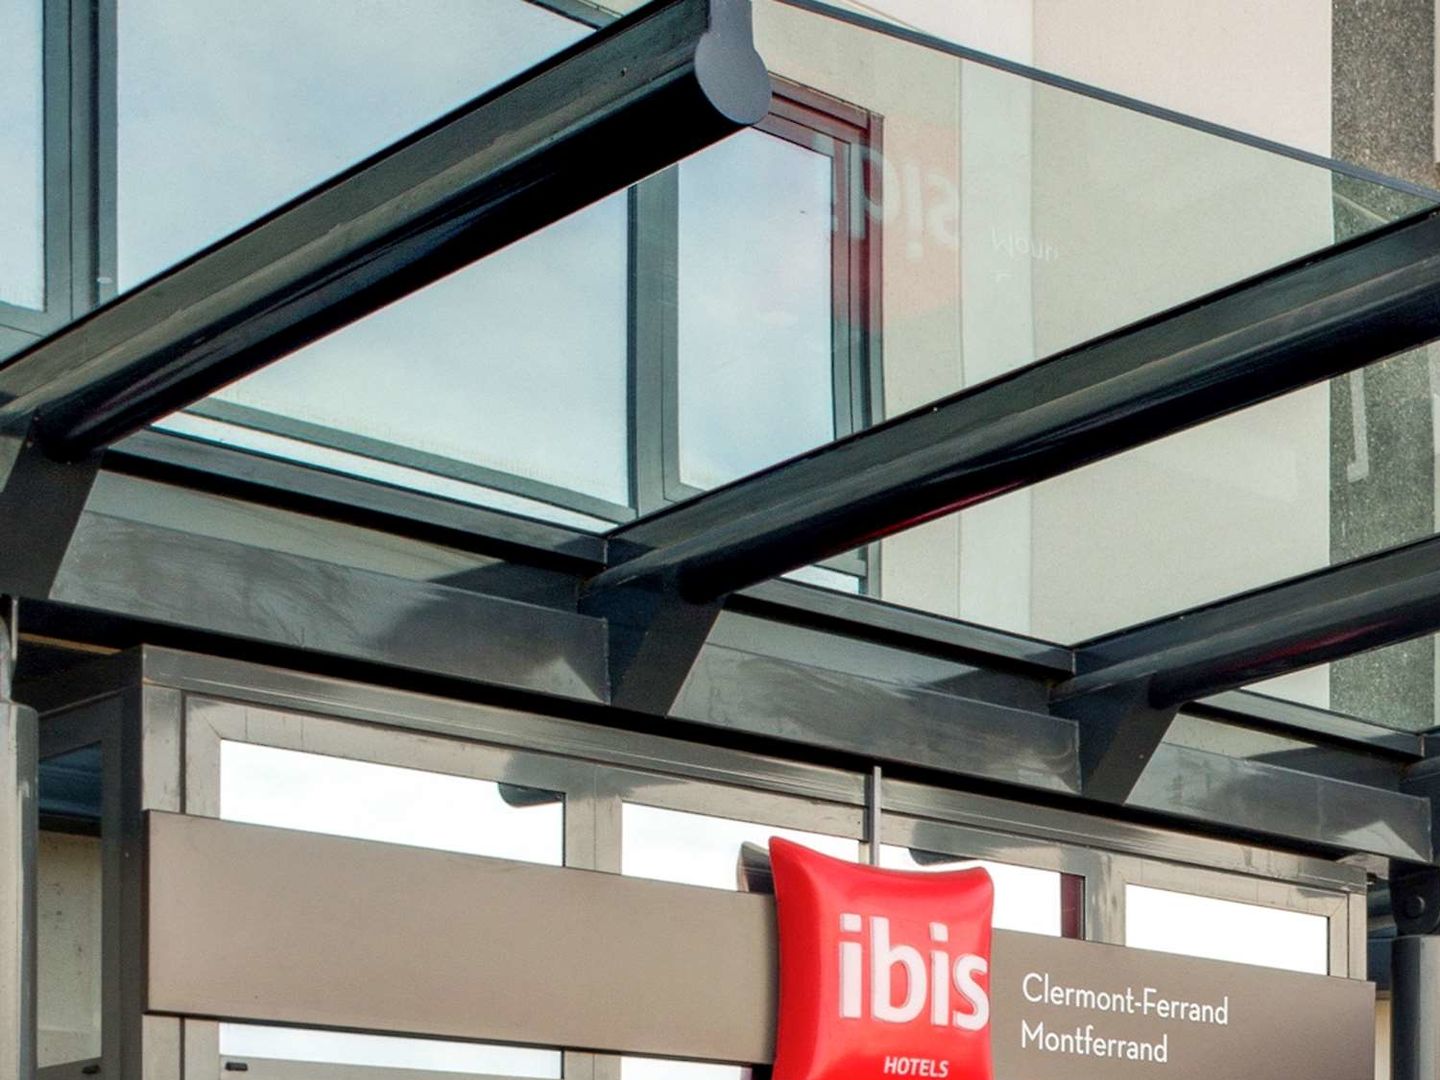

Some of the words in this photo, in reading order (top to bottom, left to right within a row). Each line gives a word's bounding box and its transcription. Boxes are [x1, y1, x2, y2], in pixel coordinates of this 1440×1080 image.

[839, 912, 990, 1031] ibis
[1022, 972, 1229, 1025] Clermont-Ferrand
[1021, 1019, 1168, 1063] Montferrand
[883, 1056, 949, 1078] HOTELS
